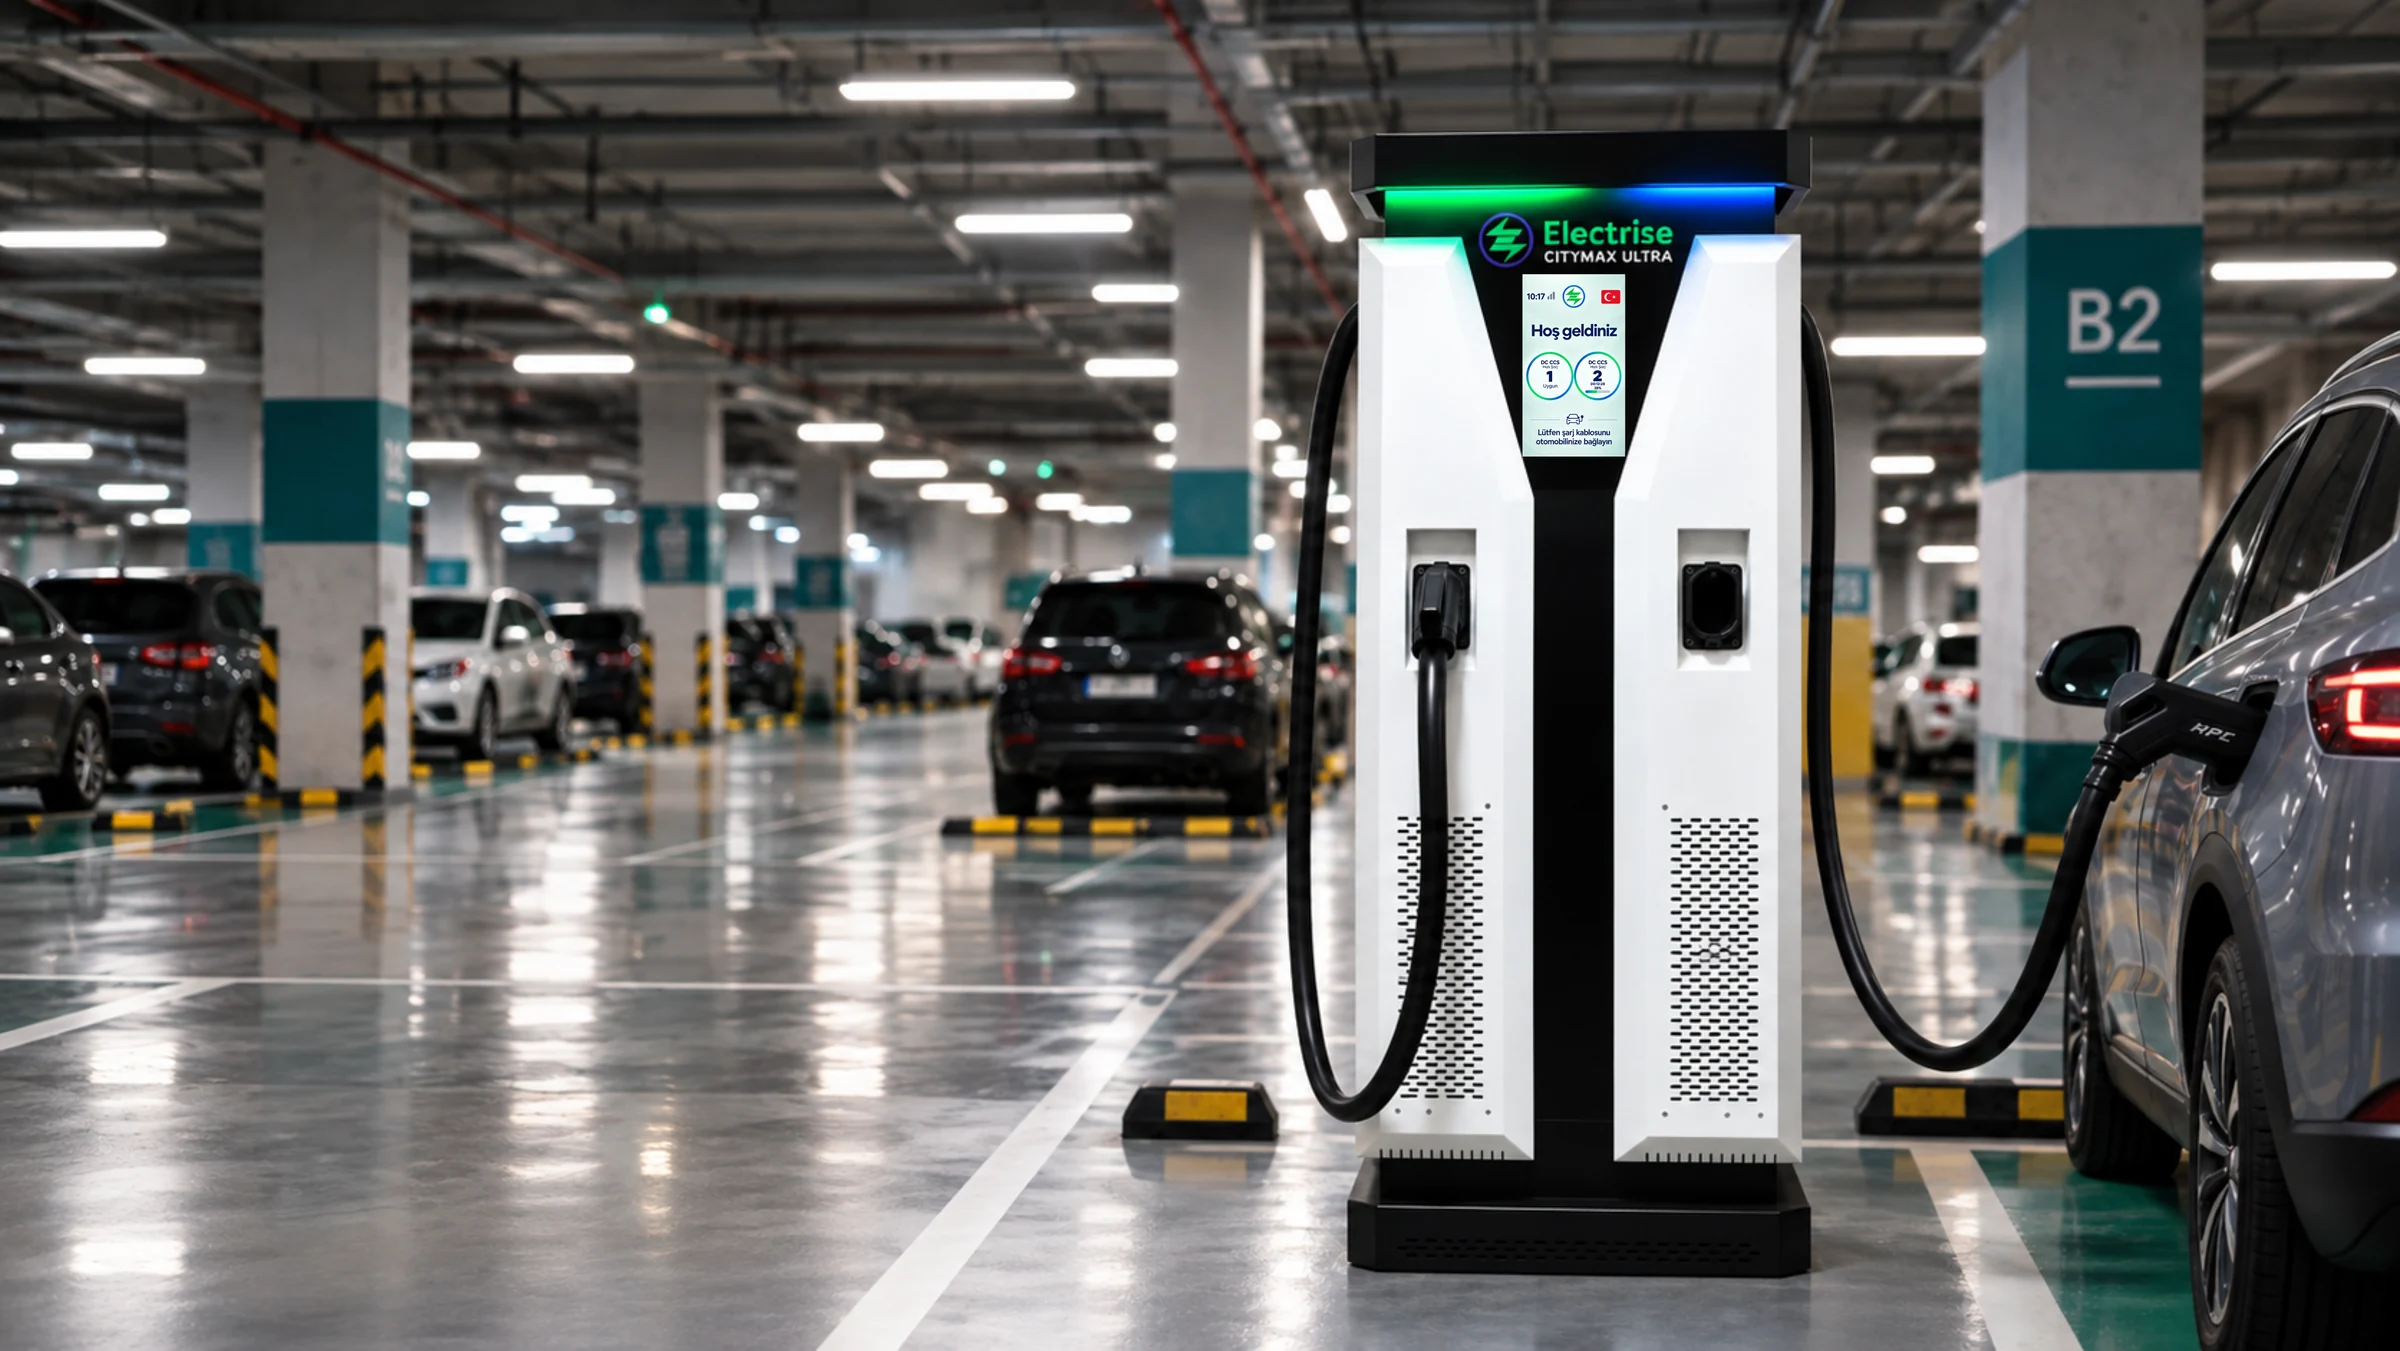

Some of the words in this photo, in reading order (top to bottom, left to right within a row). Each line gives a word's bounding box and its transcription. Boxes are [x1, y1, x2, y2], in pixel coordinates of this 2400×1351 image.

[1544, 219, 1673, 245] Electrise
[1544, 250, 1617, 263] CITYMAX
[1622, 250, 1673, 263] ULTRA
[2069, 286, 2161, 353] B2
[1531, 324, 1560, 340] Hoş
[1562, 323, 1617, 340] geldiniz
[1546, 371, 1553, 382] 1
[1593, 370, 1603, 381] 2
[1562, 429, 1575, 437] şarj
[1583, 438, 1612, 446] bağlayın
